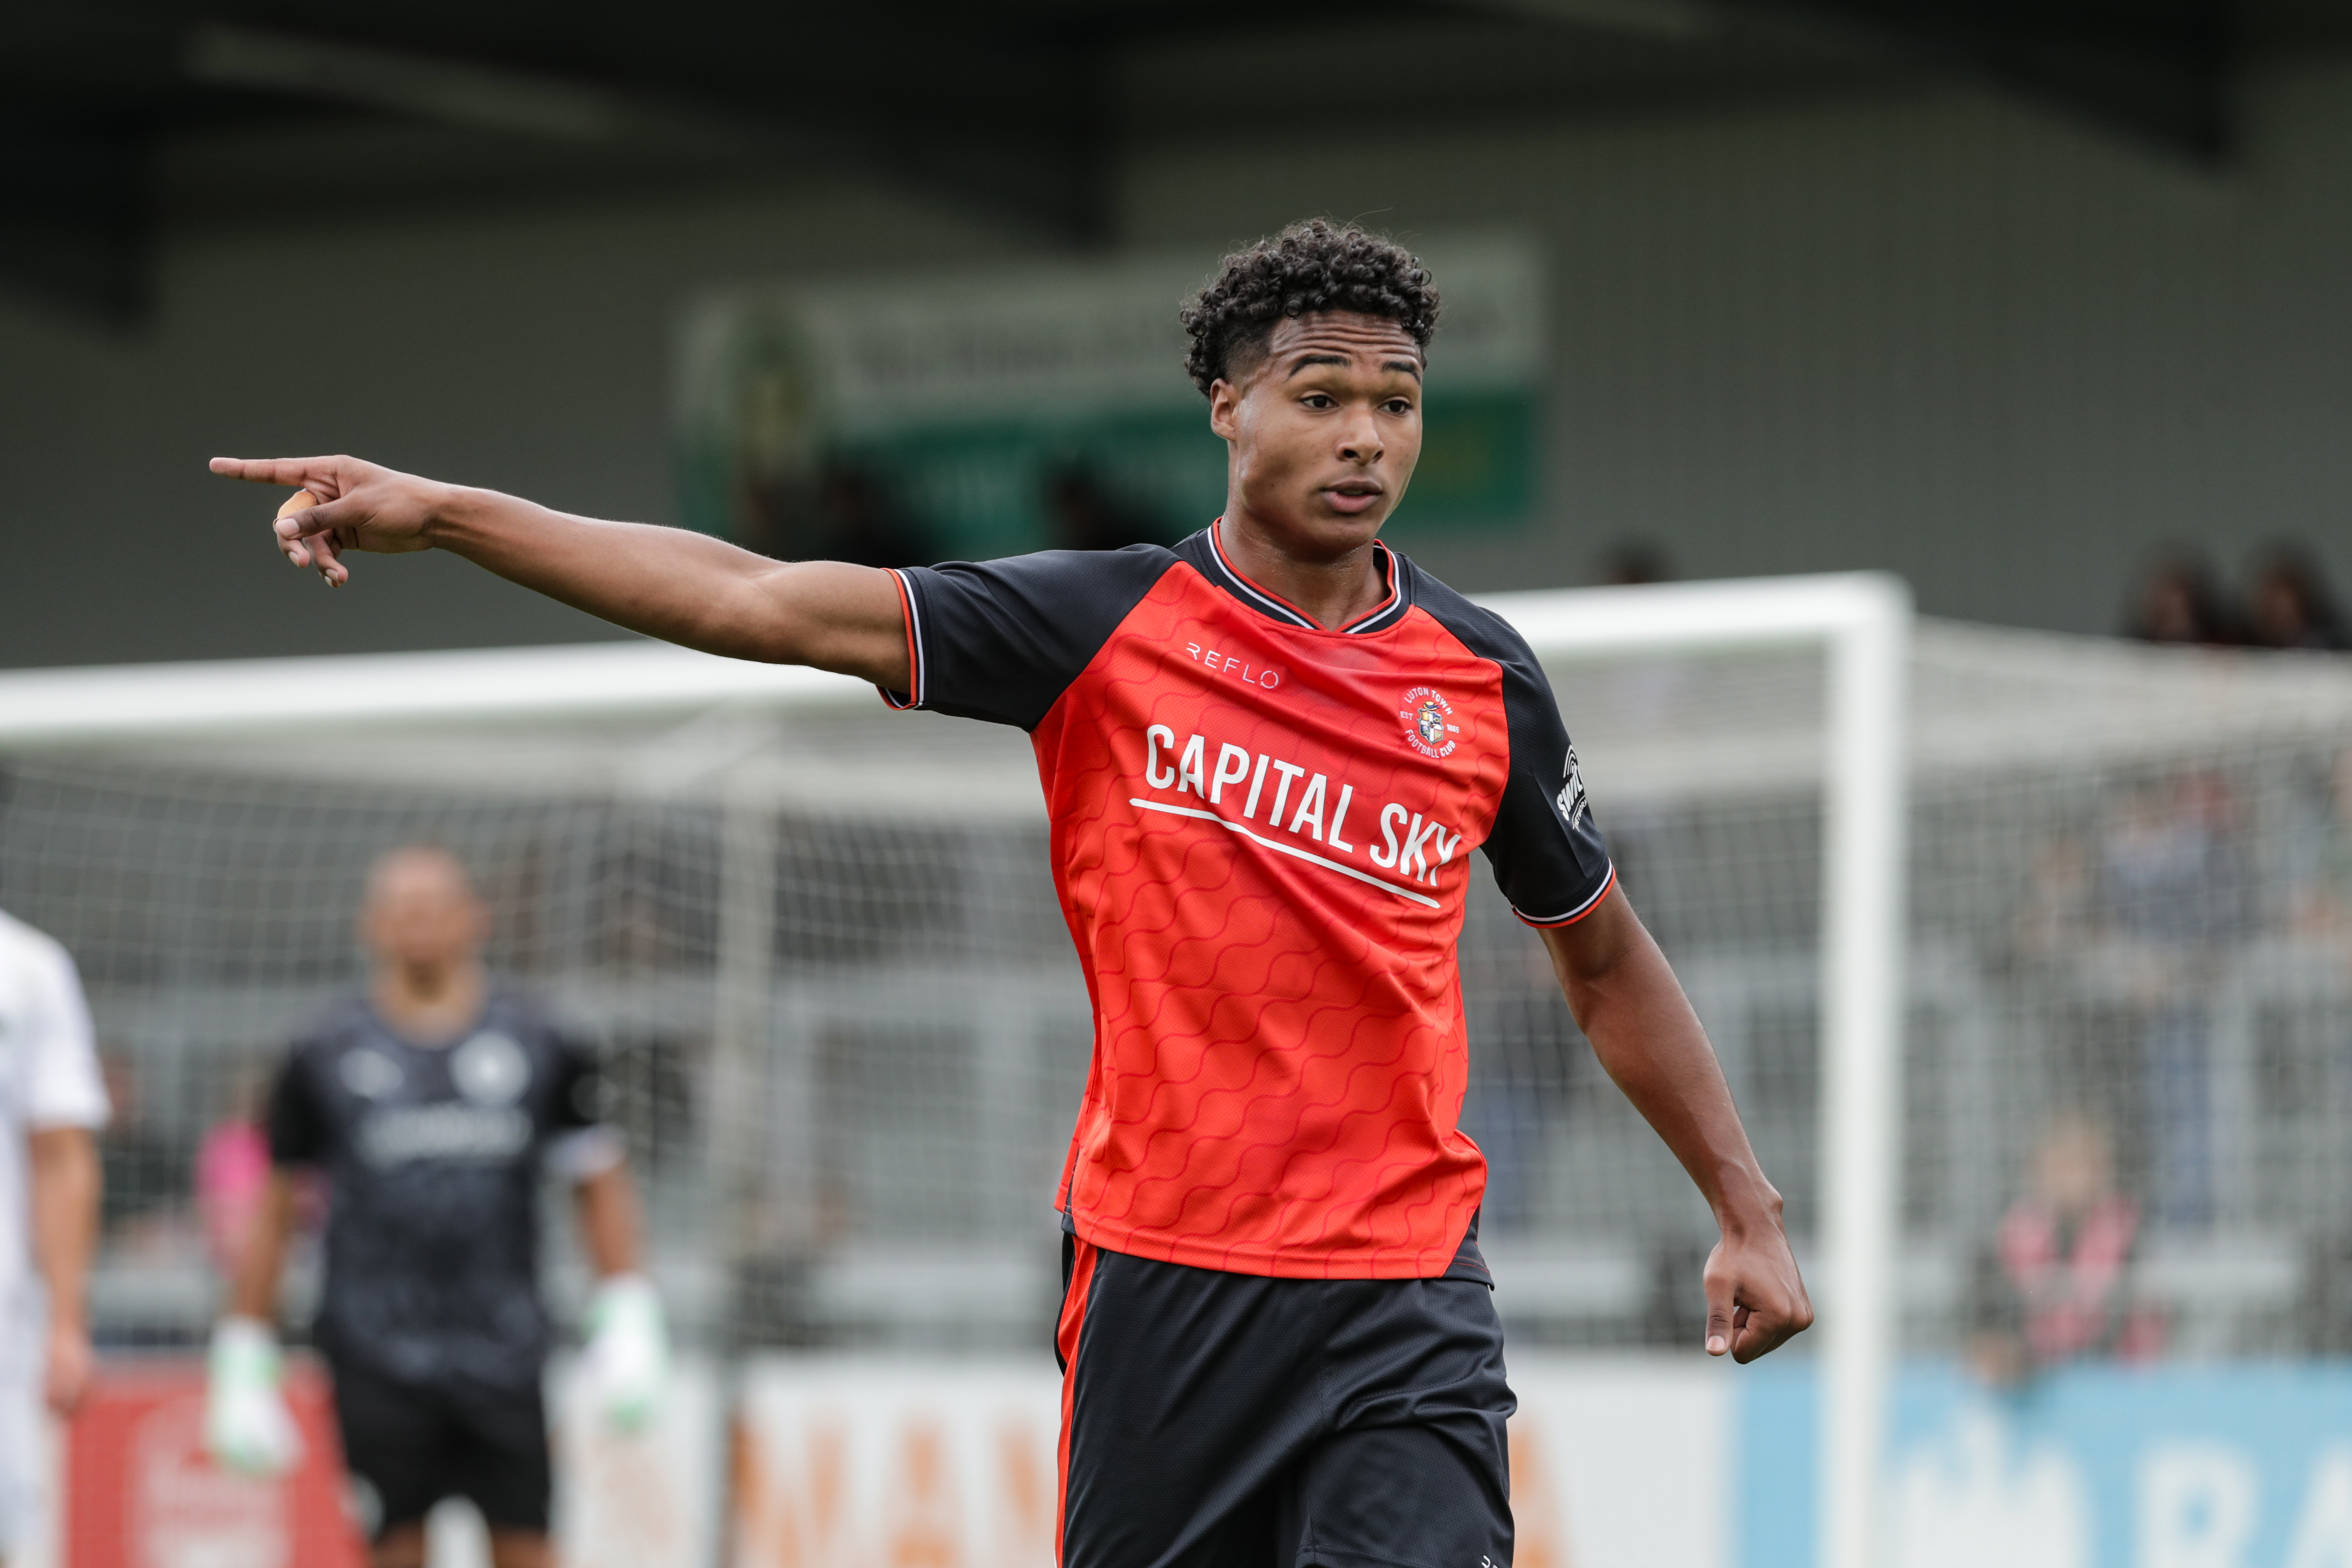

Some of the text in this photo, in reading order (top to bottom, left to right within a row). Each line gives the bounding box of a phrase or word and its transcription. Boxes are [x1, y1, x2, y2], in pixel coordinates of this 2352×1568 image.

[1186, 642, 1279, 689] REFLO
[1400, 711, 1413, 720] EST
[1404, 687, 1453, 715] LUTON TOWN
[1405, 729, 1456, 758] FOOTBALL CLUB
[1146, 724, 1461, 887] CAPITAL SKY
